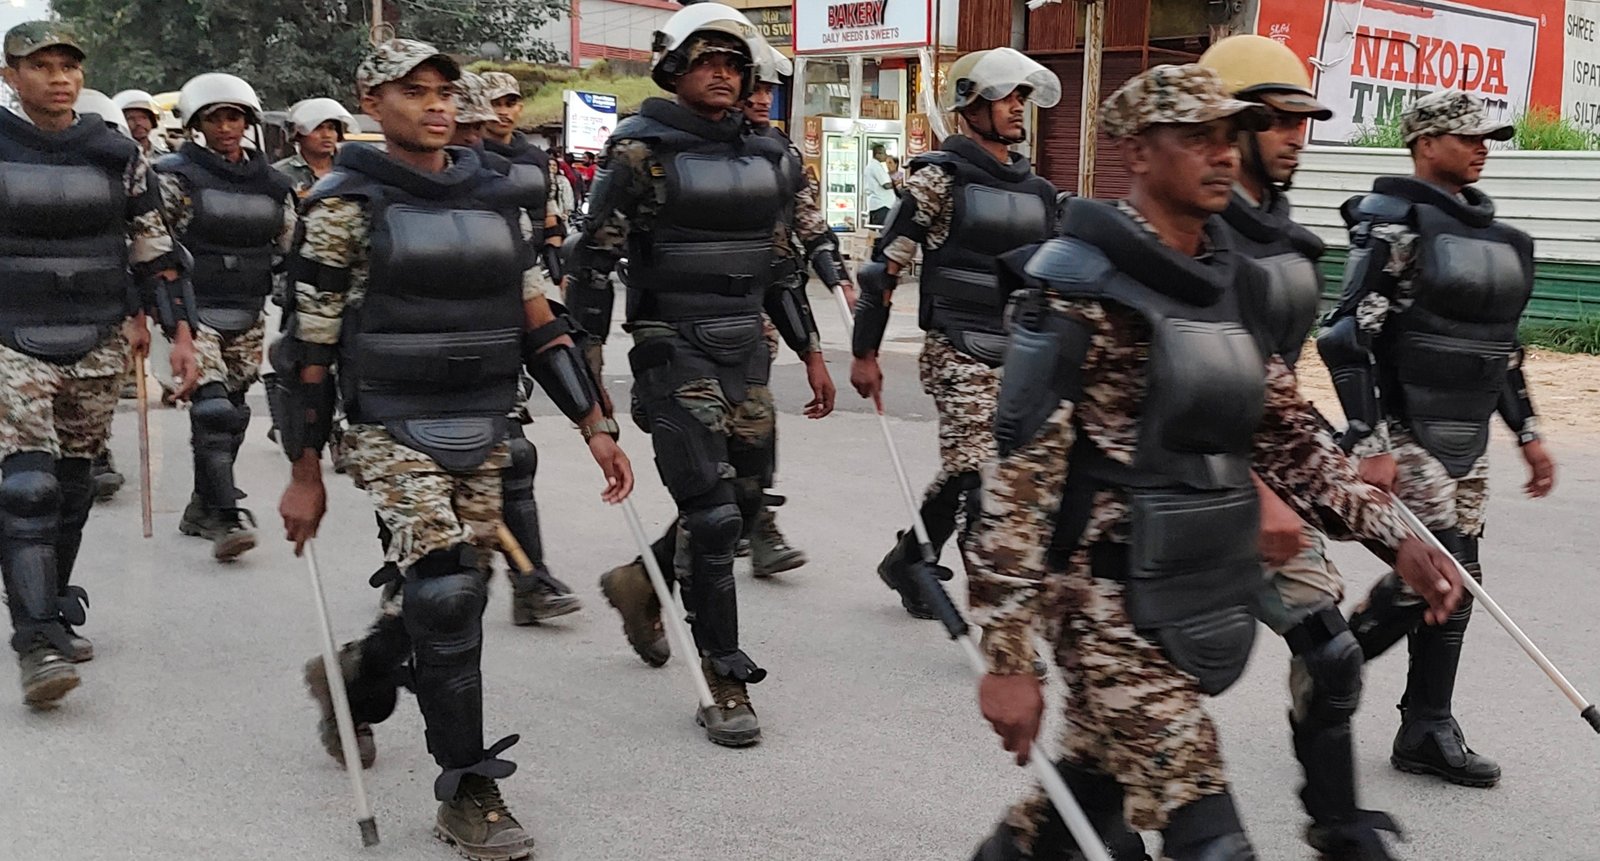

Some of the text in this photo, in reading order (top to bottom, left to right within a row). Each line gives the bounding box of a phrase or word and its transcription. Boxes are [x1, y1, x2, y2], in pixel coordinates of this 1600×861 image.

[828, 1, 886, 29] BAKERY
[1567, 14, 1595, 42] SHREE
[772, 23, 792, 36] STU
[822, 27, 899, 43] DAILY NEEDS & SWEETS
[1350, 25, 1509, 95] NAKODA
